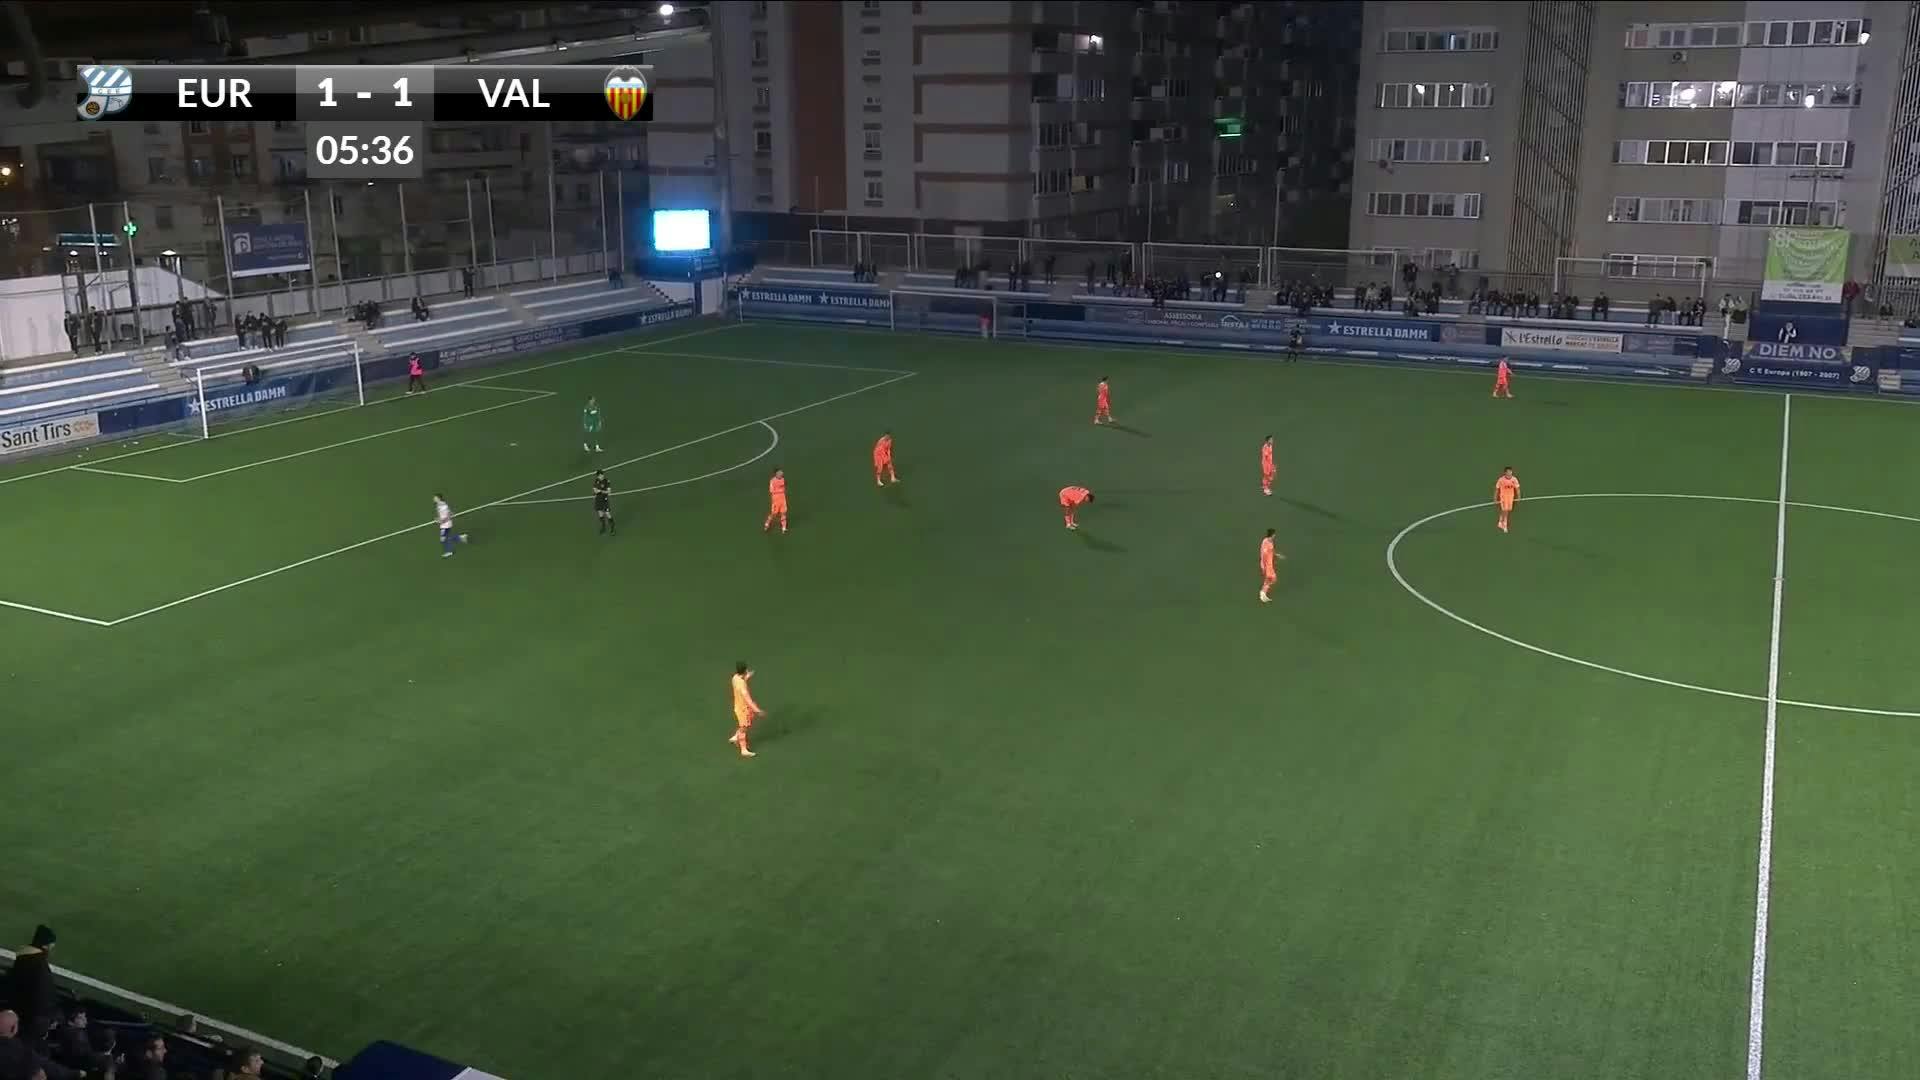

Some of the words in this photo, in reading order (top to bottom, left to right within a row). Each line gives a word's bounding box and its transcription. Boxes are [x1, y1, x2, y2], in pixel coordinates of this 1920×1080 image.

[752, 291, 786, 302] ESTRELLA
[788, 294, 812, 304] DAMM
[830, 297, 867, 307] ESTRELLA
[1343, 325, 1393, 338] ESTRELLA
[1394, 328, 1428, 340] DAMM
[1759, 343, 1804, 358] DIEM
[1808, 347, 1837, 360] NO
[204, 392, 254, 412] ESTRELLA
[254, 386, 286, 402] DAMM
[1, 426, 39, 448] Sant
[41, 423, 71, 440] Tirs
